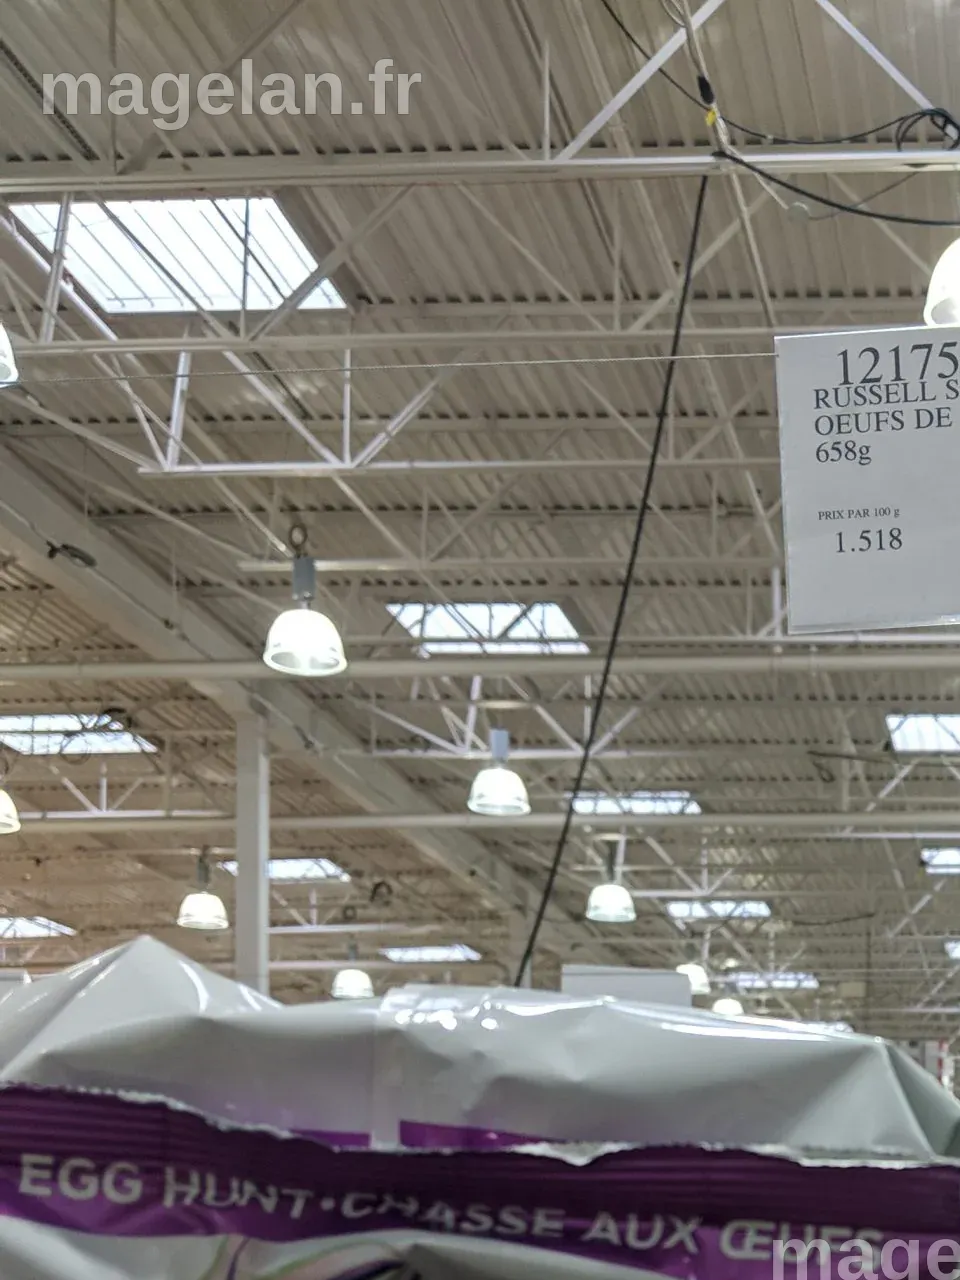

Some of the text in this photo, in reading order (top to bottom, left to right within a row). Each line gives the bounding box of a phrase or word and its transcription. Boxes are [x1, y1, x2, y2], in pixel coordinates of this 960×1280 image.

[813, 380, 937, 410] RUSSELL
[814, 409, 905, 436] OEUFS
[915, 406, 953, 430] DE
[815, 439, 872, 466] 658g
[818, 510, 845, 521] PRIX
[847, 508, 871, 519] PAR
[874, 506, 891, 517] 100
[836, 527, 903, 553] 1.518
[18, 1153, 144, 1201] EGG
[581, 1209, 702, 1255] AUX
